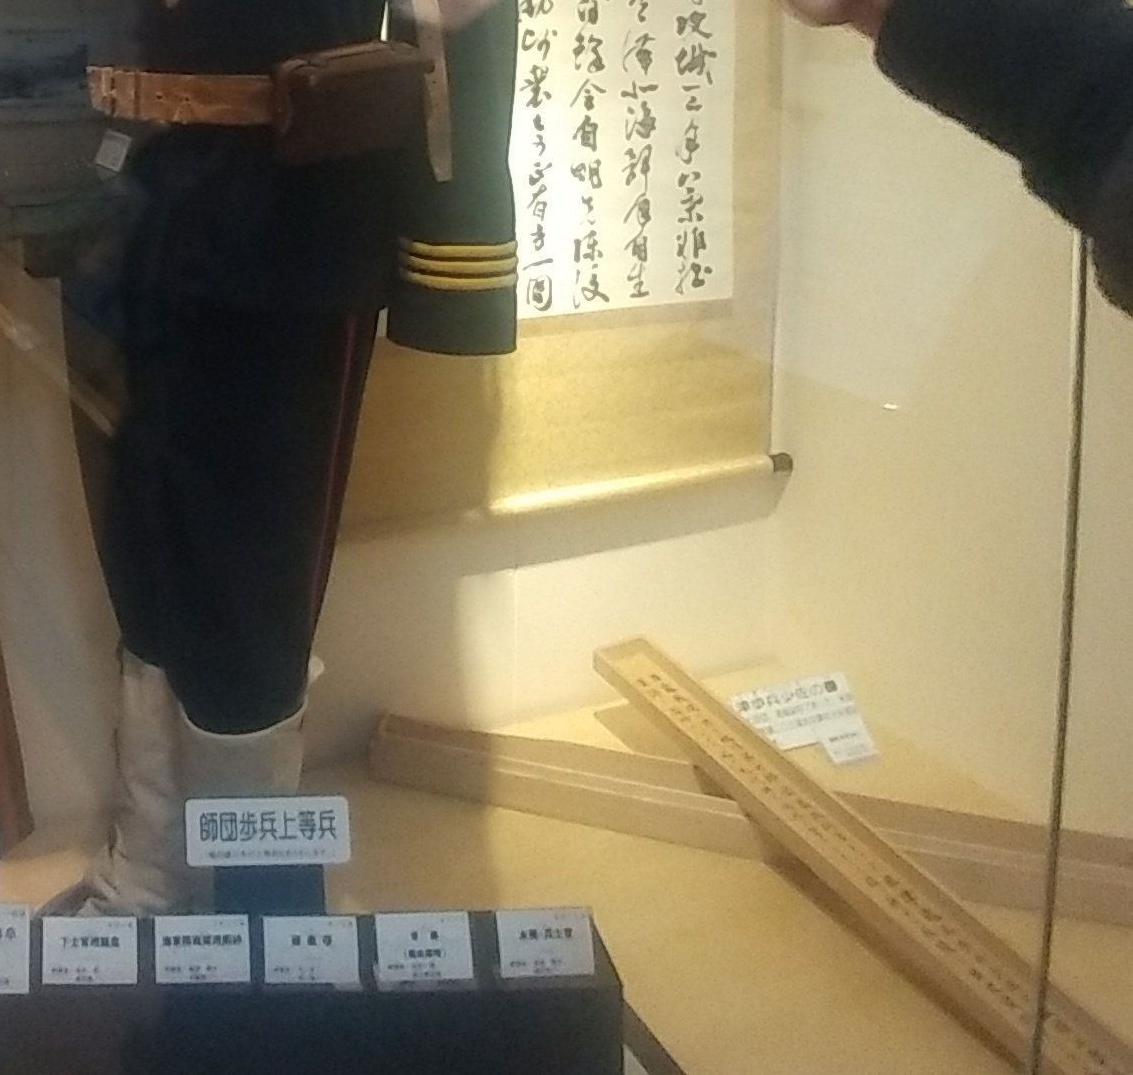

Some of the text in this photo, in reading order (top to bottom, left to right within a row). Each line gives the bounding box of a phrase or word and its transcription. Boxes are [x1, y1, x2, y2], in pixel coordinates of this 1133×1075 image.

[200, 809, 338, 842] 師団歩兵上等兵
